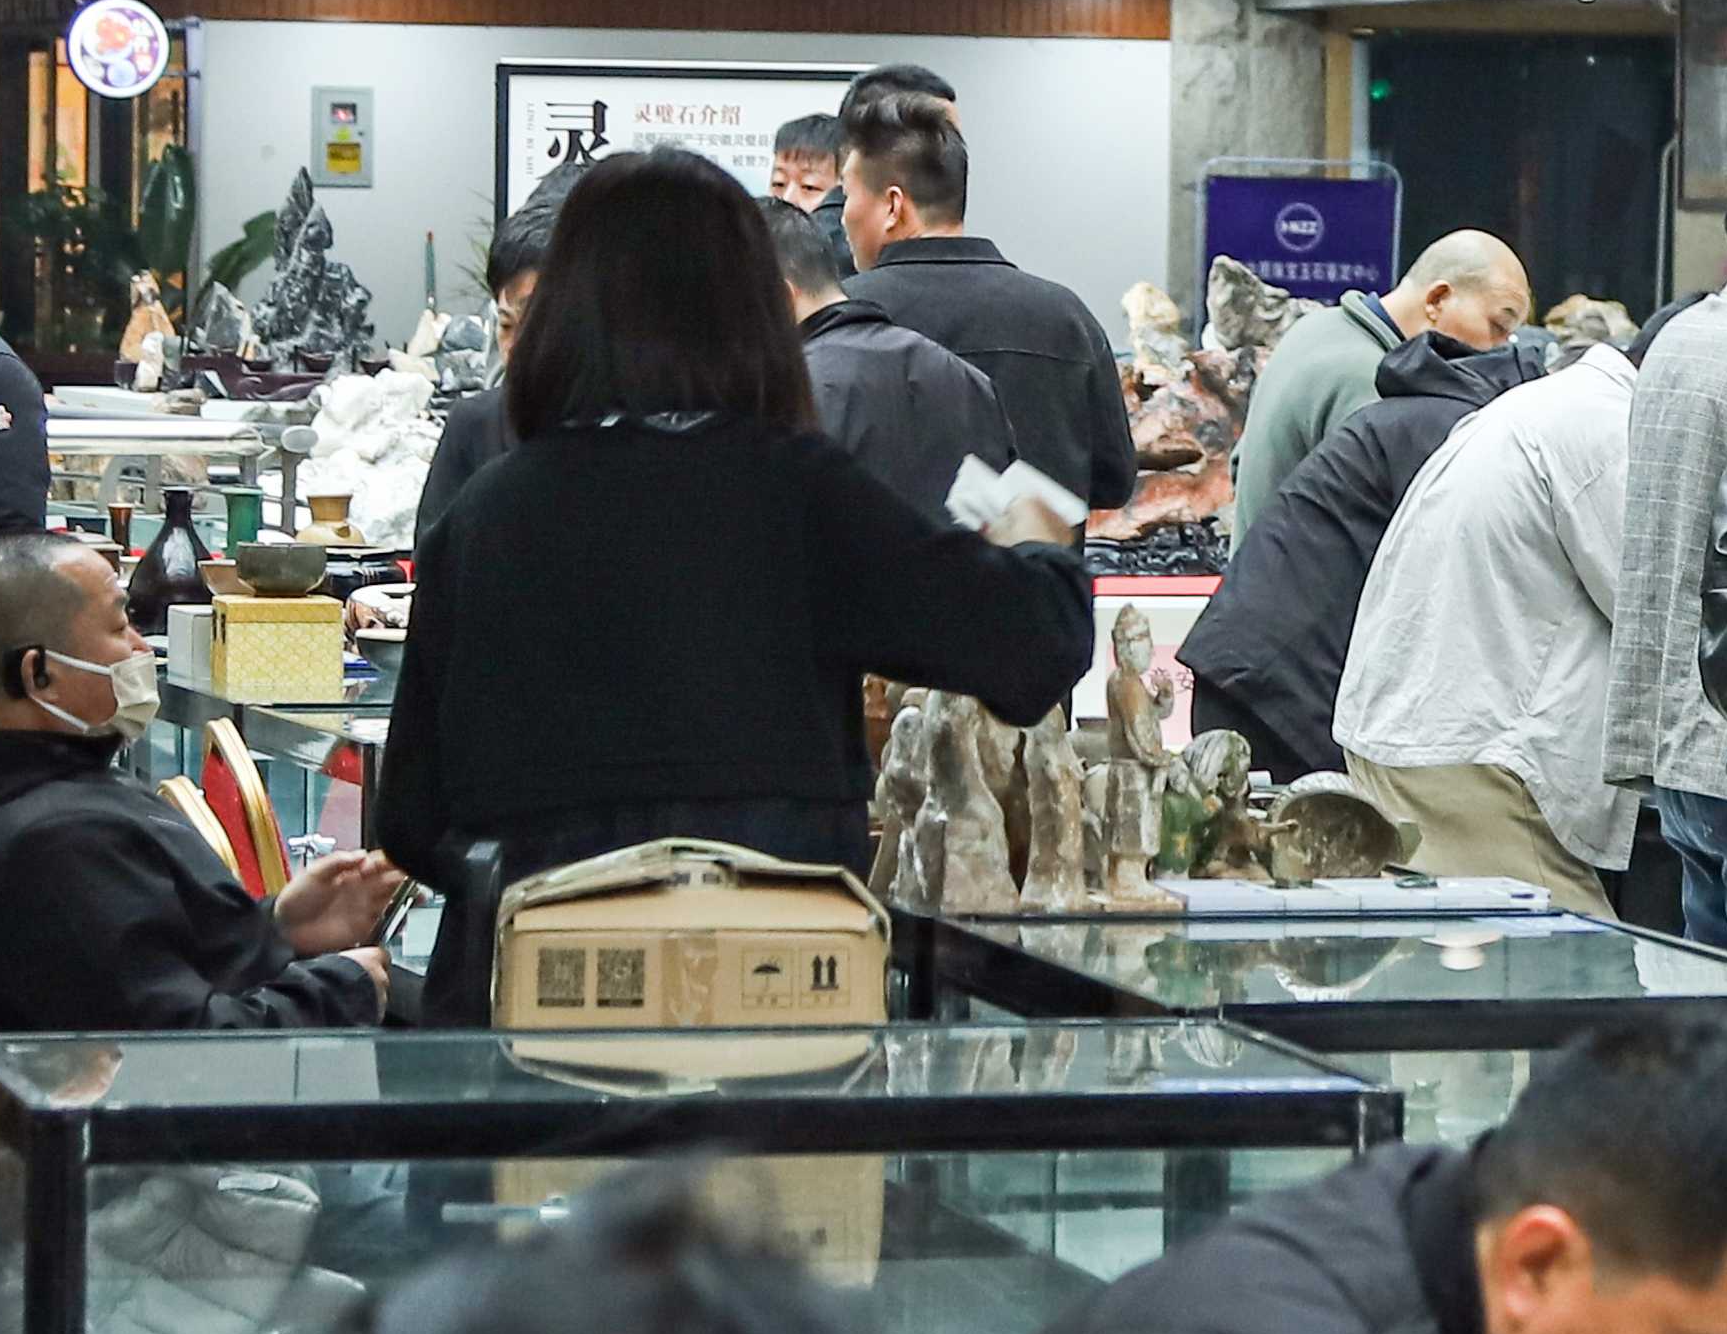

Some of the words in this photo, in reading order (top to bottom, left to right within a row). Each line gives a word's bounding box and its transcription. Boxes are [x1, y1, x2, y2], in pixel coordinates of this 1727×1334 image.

[634, 103, 741, 125] 灵璧石介绍
